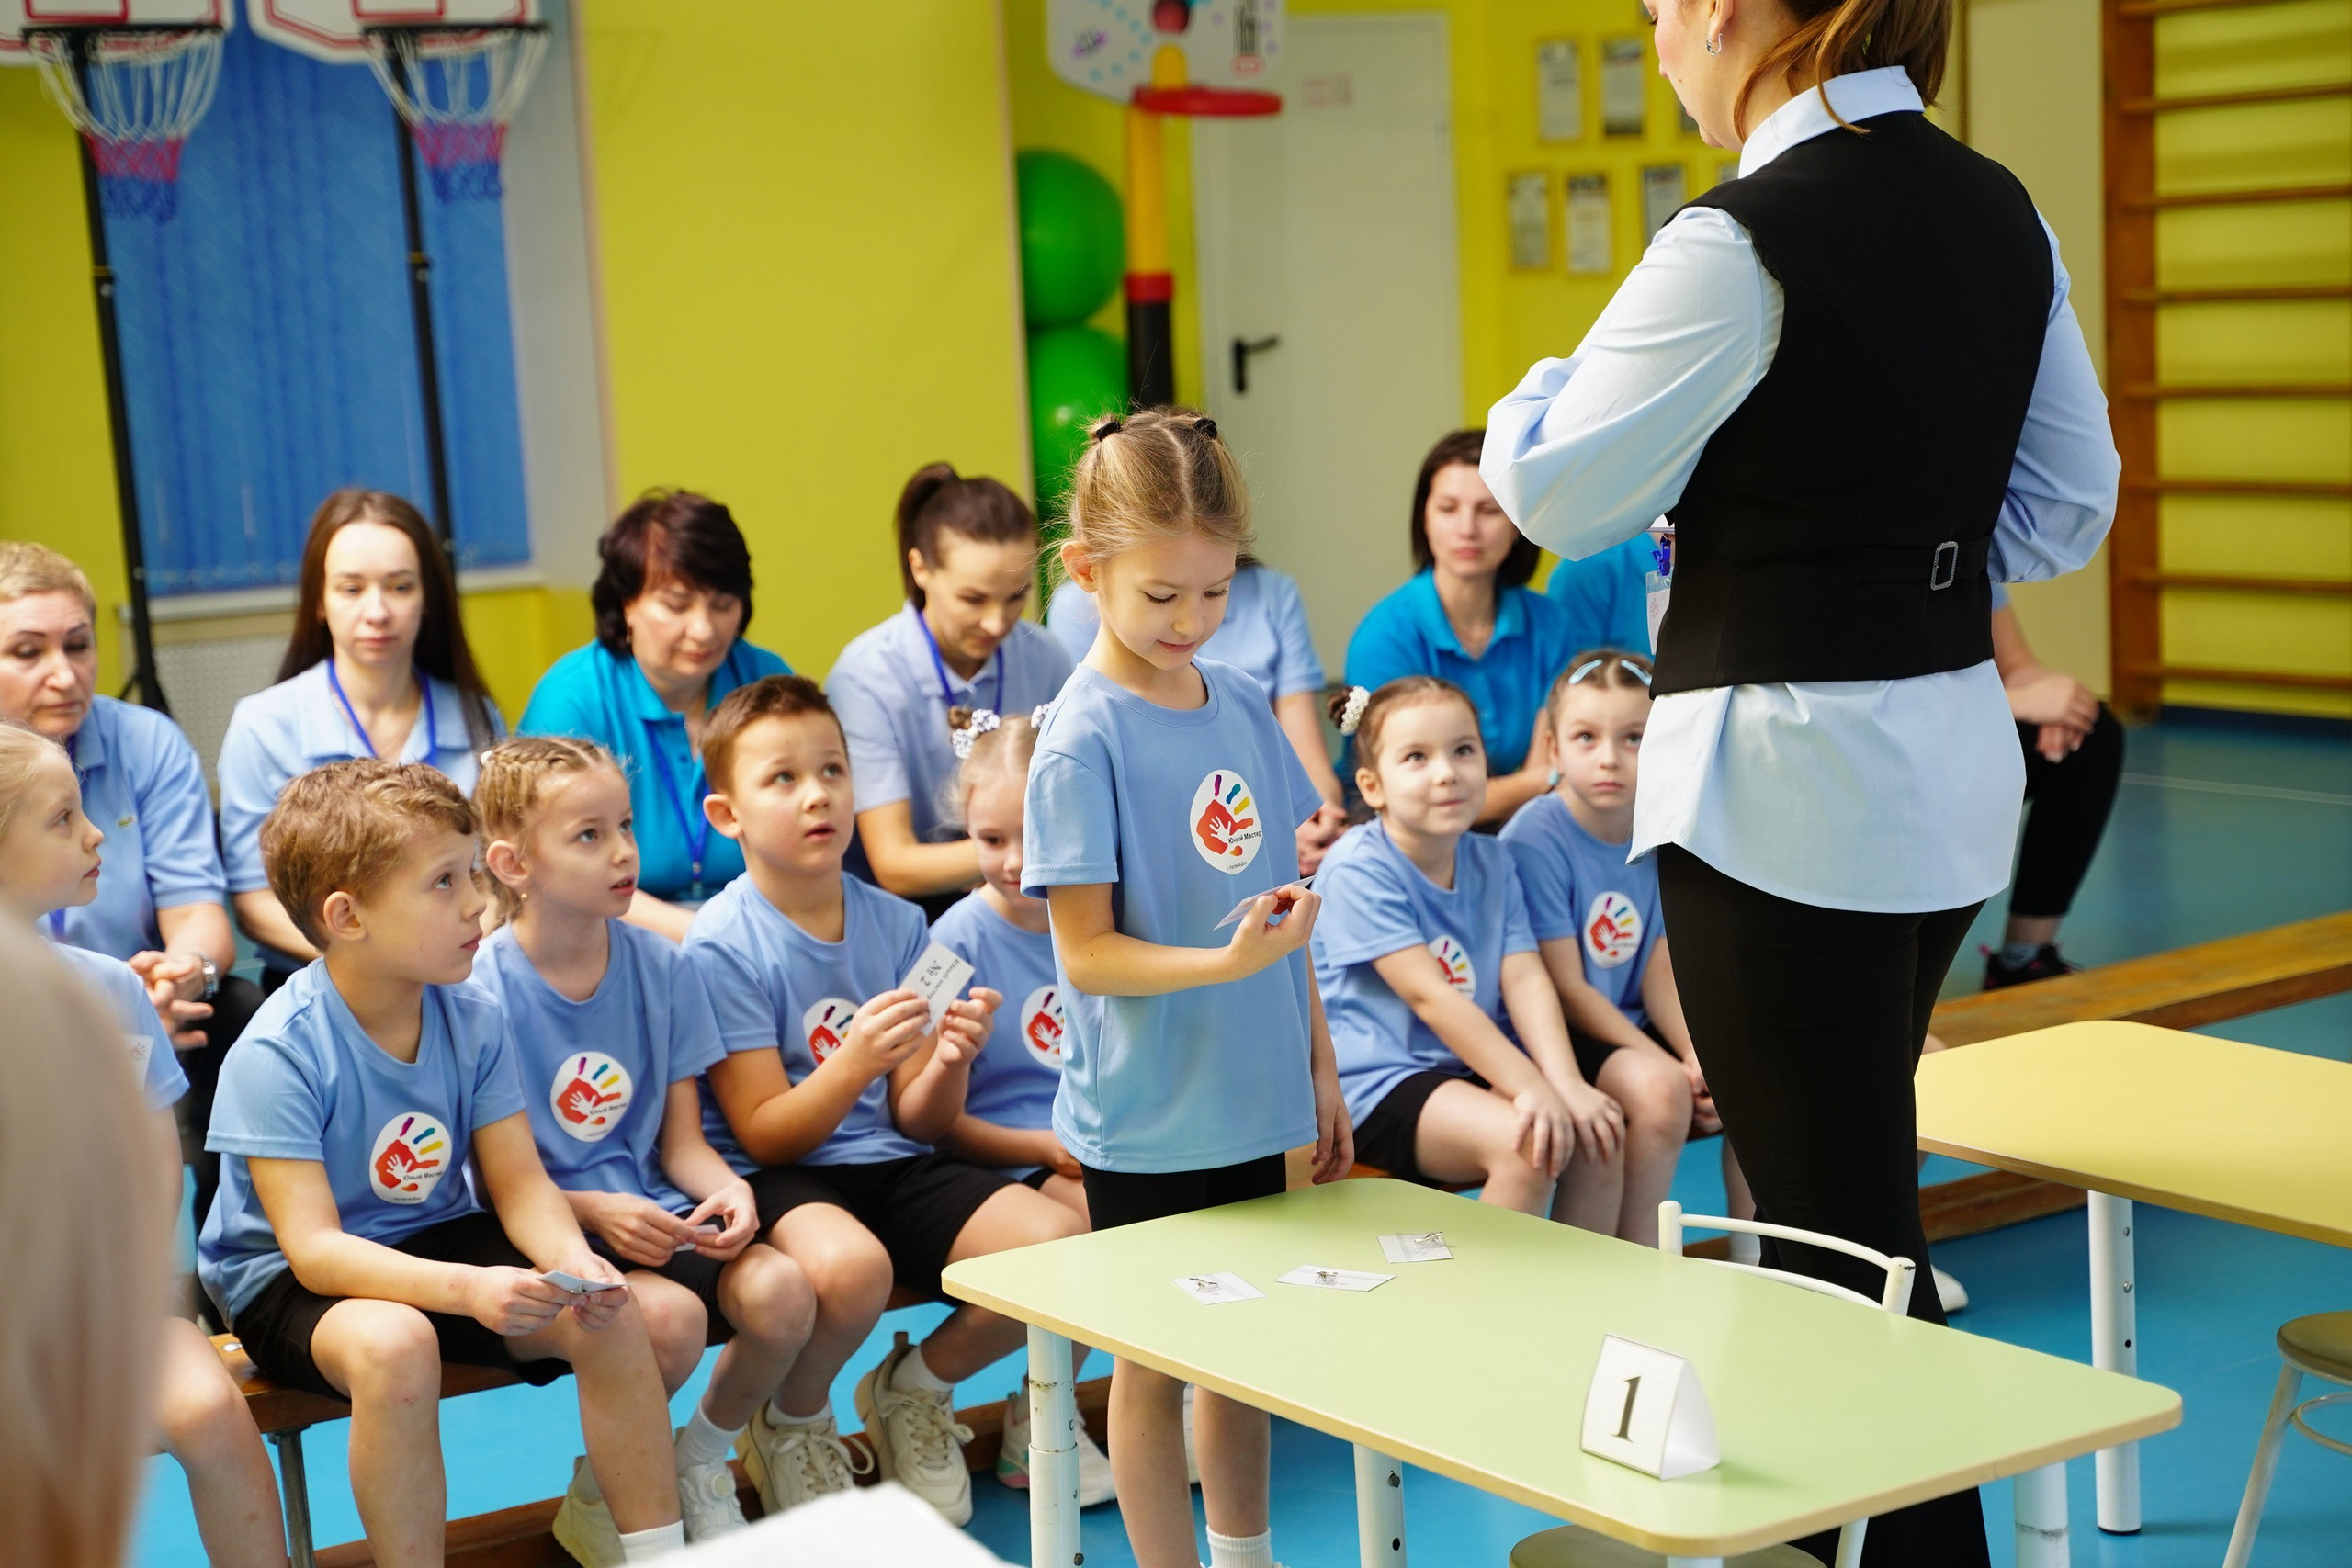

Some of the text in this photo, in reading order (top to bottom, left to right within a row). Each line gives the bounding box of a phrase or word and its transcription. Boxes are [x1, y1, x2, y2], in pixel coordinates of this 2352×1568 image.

[1228, 830, 1261, 844] Юный Мастер
[920, 976, 931, 987] 2
[1611, 1375, 1642, 1443] 1
